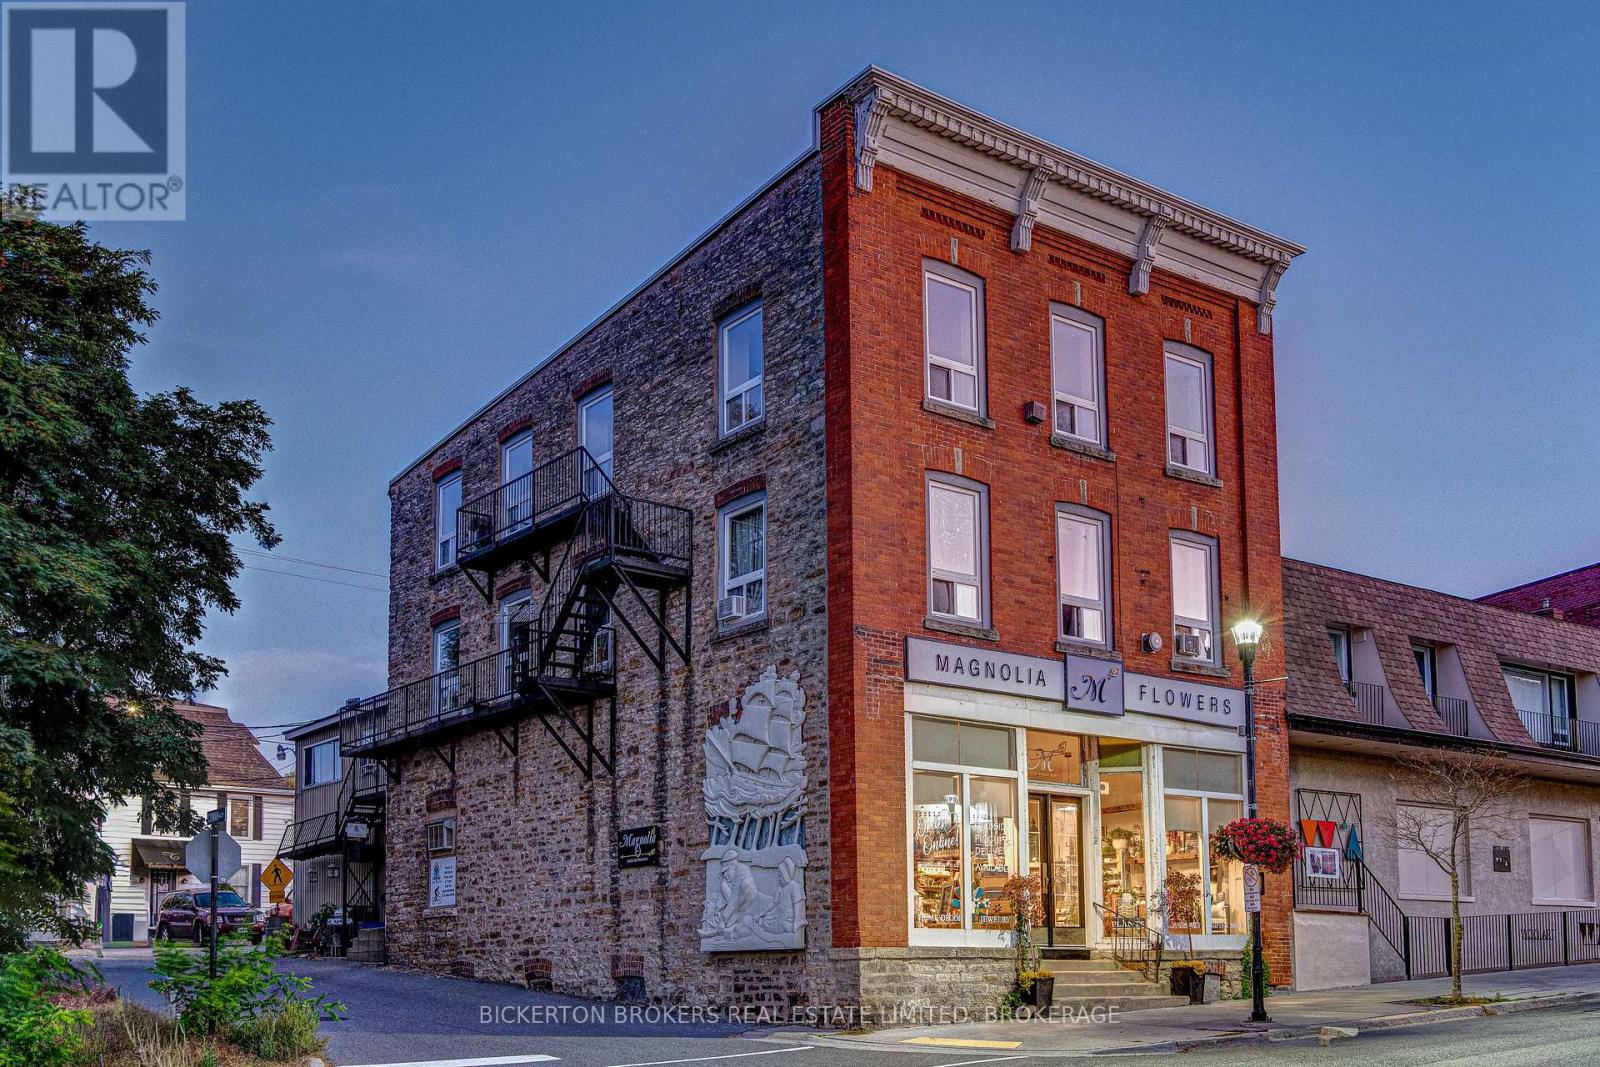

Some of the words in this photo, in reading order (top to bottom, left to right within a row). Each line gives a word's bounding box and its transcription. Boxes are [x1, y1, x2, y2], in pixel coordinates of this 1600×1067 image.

[936, 654, 1046, 687] MAGNOLIA
[1138, 685, 1232, 715] FLOWERS
[1070, 675, 1106, 703] M
[1111, 919, 1145, 928] PLANTS
